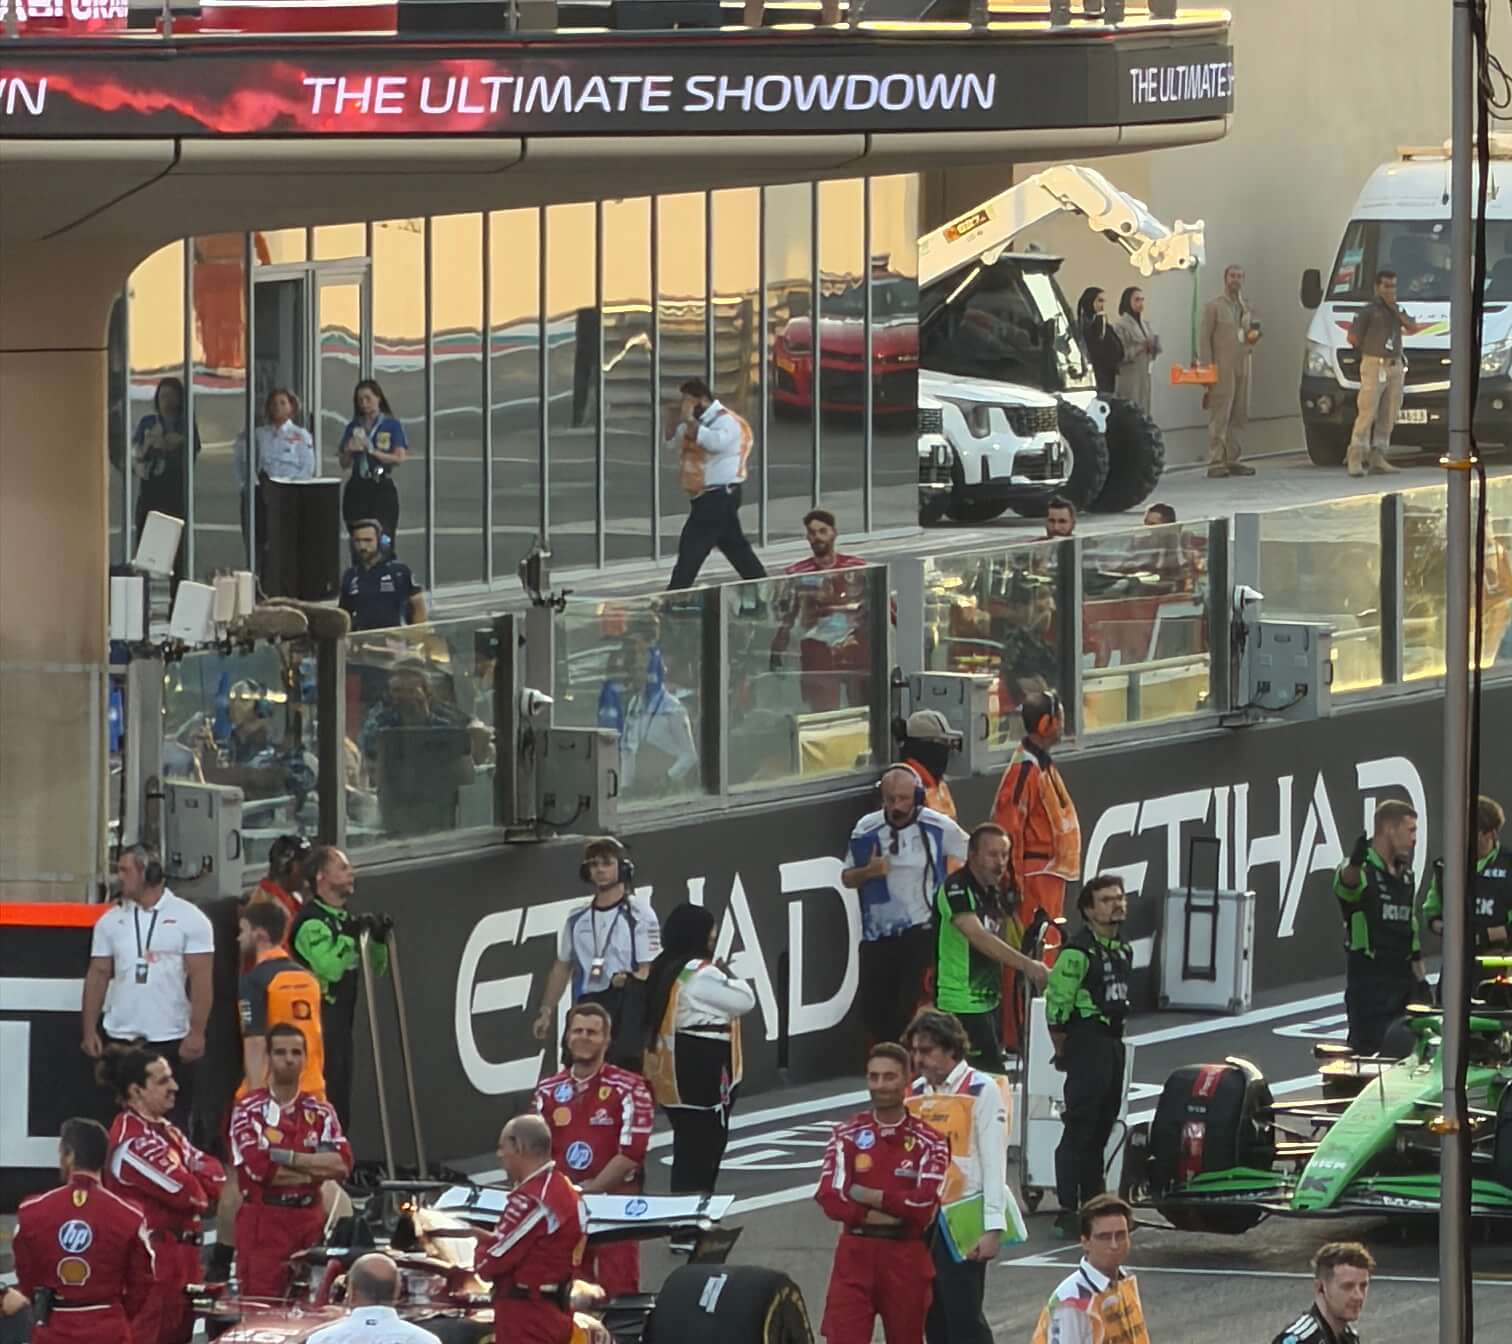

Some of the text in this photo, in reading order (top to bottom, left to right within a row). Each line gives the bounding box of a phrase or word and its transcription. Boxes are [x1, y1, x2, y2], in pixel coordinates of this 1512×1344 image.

[302, 72, 996, 115] THE ULTIMATE SHOWDOWN
[1129, 67, 1158, 104] THE
[1160, 62, 1227, 102] ULTIMATE
[1082, 756, 1428, 969] ETIHAD
[568, 1143, 592, 1169] hp
[60, 1220, 91, 1253] hp
